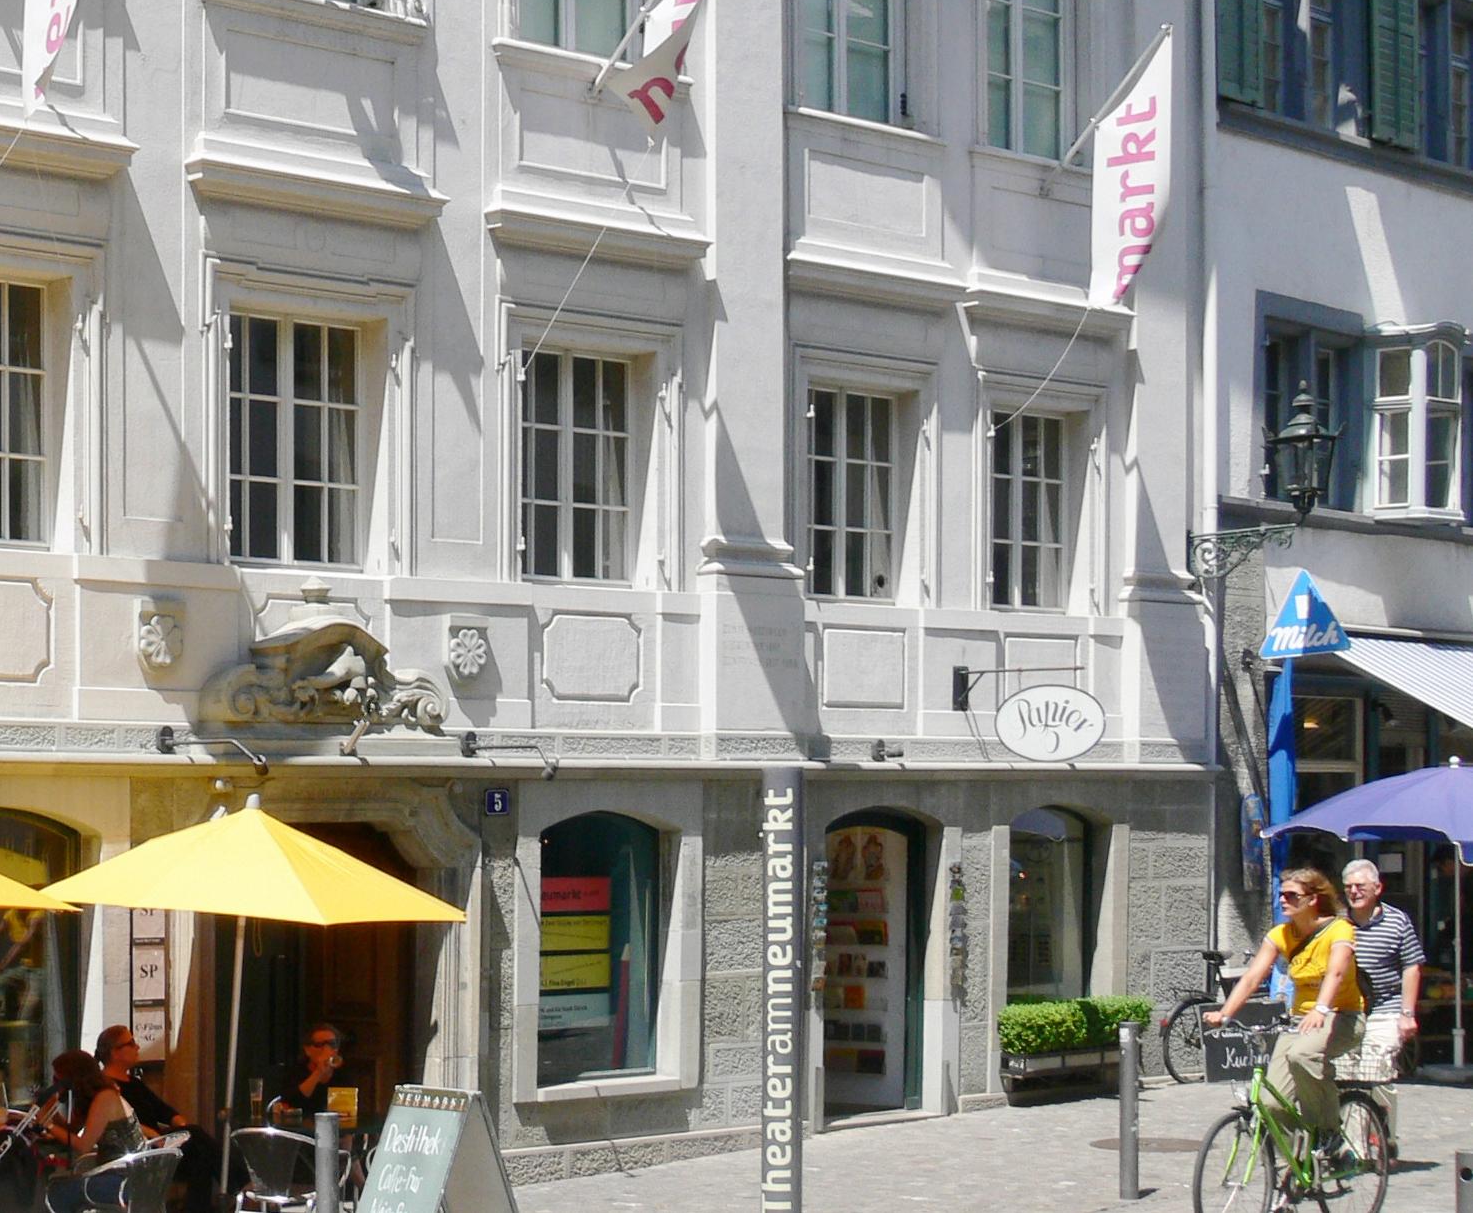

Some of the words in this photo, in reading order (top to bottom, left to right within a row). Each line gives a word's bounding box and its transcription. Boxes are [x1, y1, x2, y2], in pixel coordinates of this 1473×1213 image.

[1270, 621, 1341, 653] Milch
[1012, 698, 1095, 754] Papier
[493, 792, 503, 812] 5
[140, 963, 158, 978] SP
